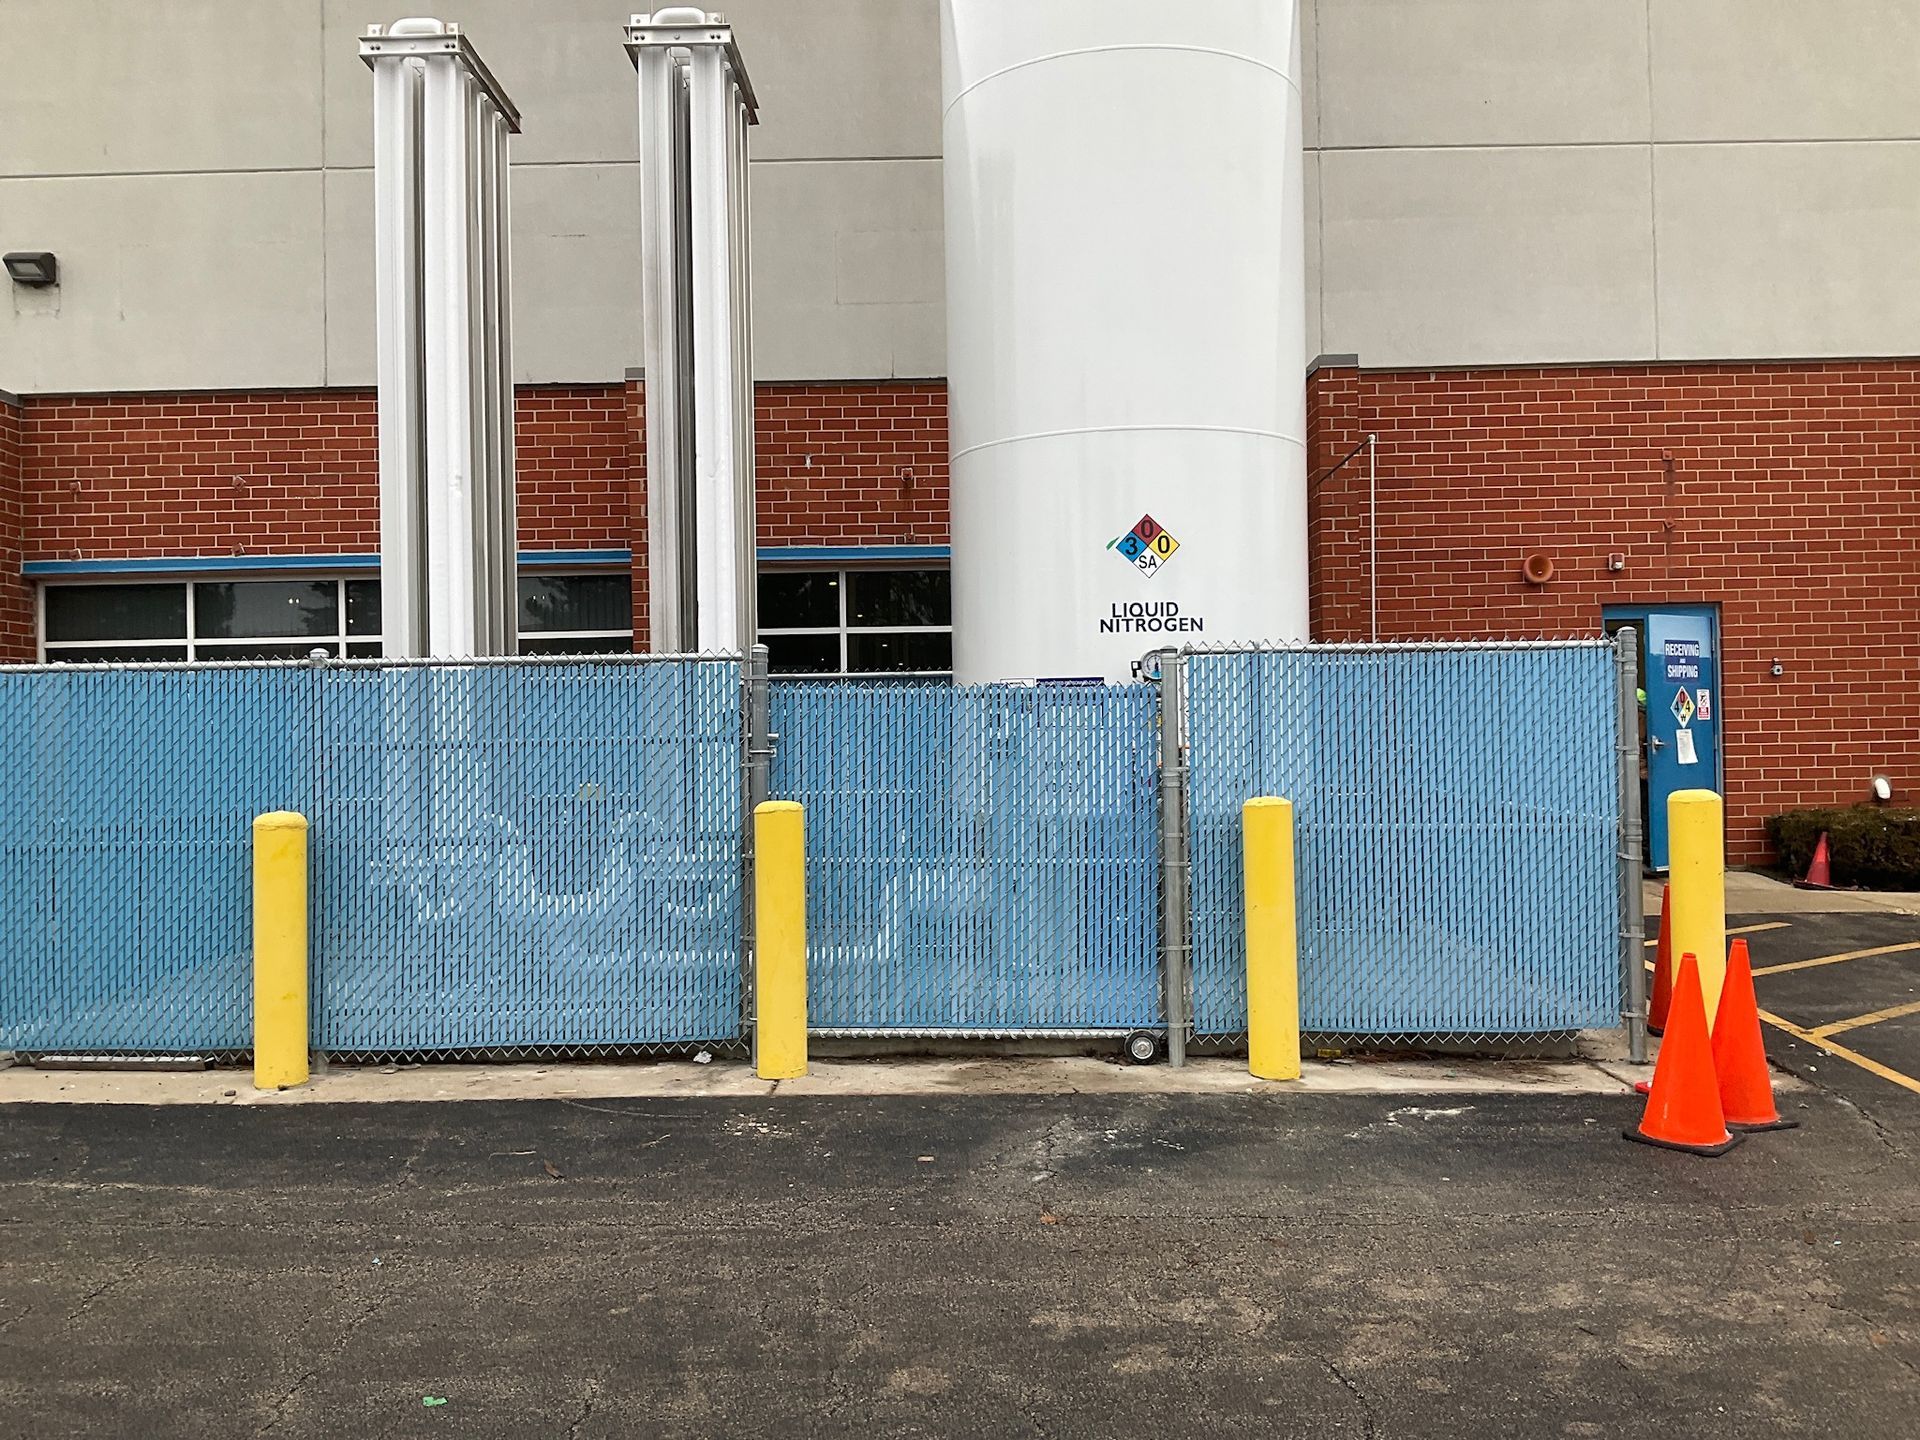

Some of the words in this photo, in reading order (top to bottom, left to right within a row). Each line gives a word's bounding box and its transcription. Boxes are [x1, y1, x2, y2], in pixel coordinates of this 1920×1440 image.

[1141, 519, 1154, 538] 0
[1125, 537, 1138, 555] 3
[1157, 535, 1170, 554] 0
[1138, 555, 1157, 569] SA
[1112, 602, 1179, 618] LIQUID
[1100, 617, 1203, 633] NITROGEN
[1666, 644, 1699, 656] RECEIVING
[1668, 665, 1698, 678] SHIPPING
[1680, 691, 1685, 703] 0
[1674, 701, 1679, 712] 4
[1686, 700, 1690, 712] 4
